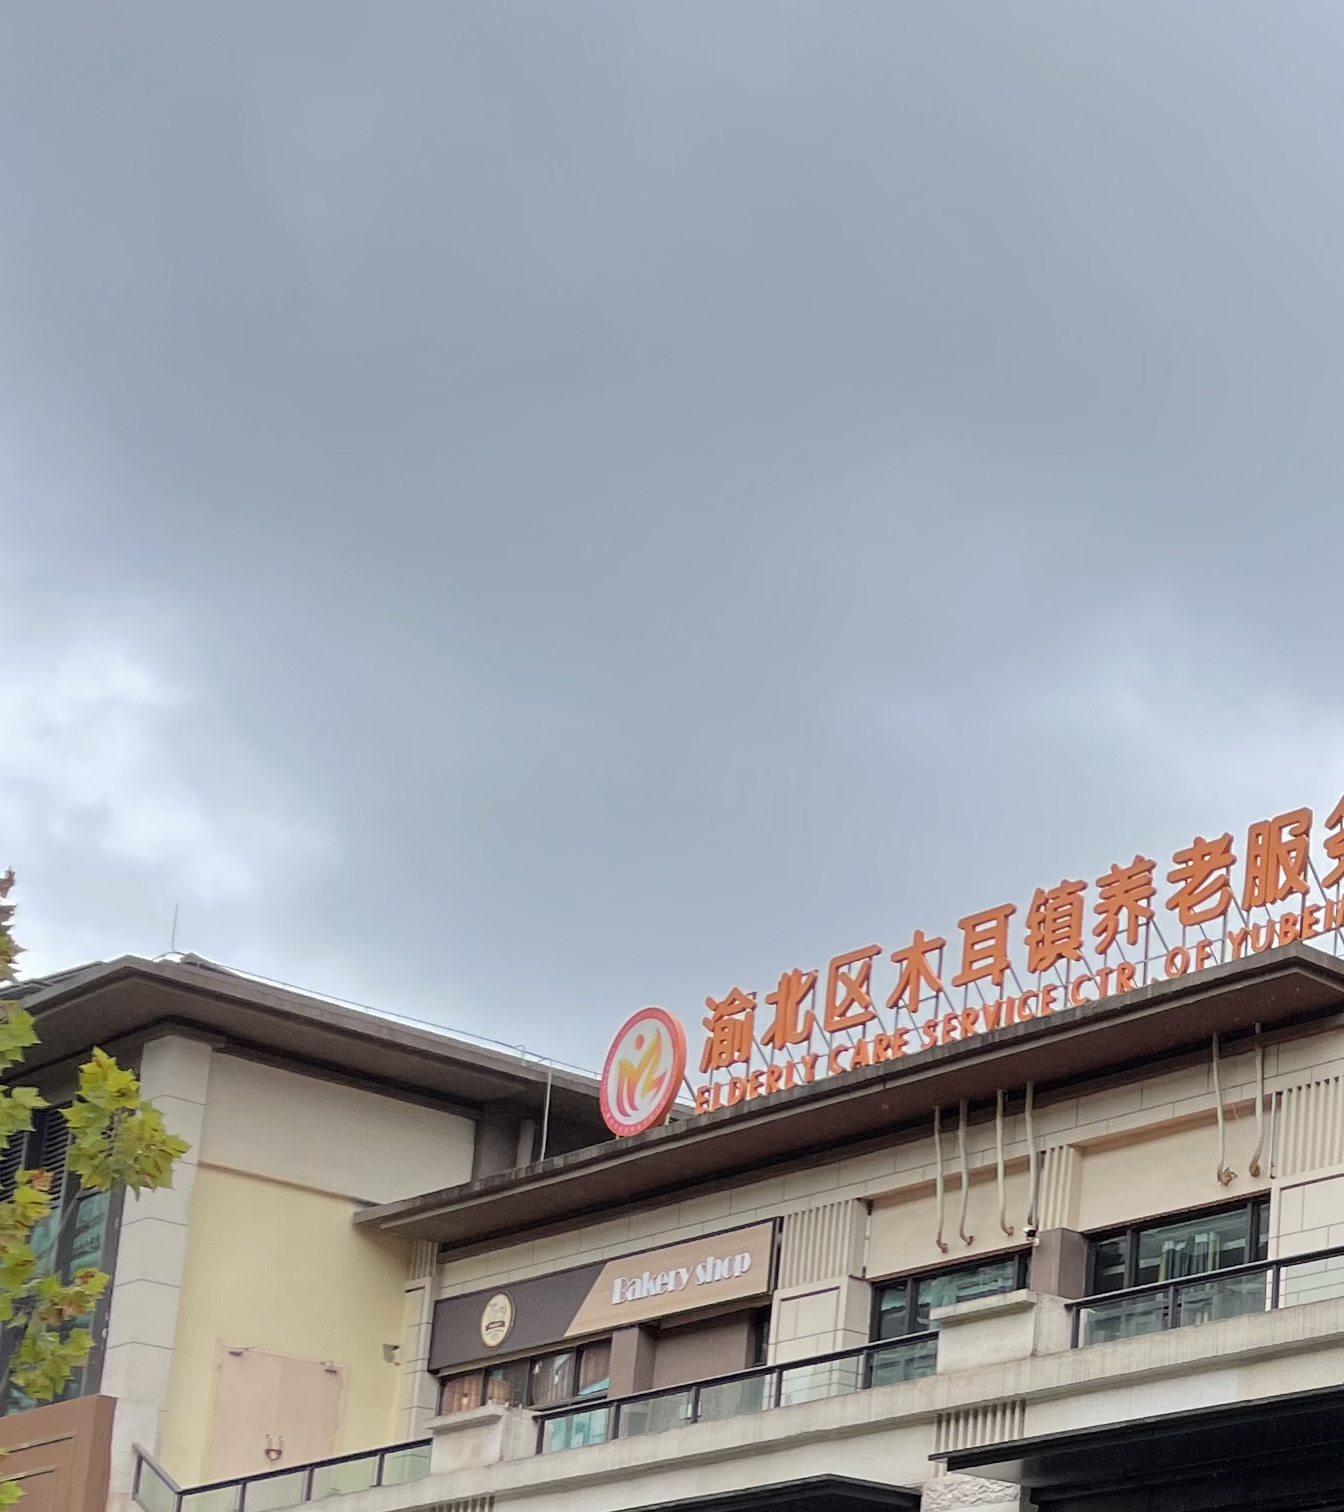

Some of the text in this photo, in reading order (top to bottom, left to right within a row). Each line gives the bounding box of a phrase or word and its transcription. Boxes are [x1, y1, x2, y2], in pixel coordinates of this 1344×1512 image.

[695, 1052, 819, 1114] ELDERLY
[827, 1027, 909, 1075] CARE
[920, 984, 1056, 1051] SERVICE
[1164, 938, 1213, 979] OF
[611, 1252, 751, 1305] Bakery shop
